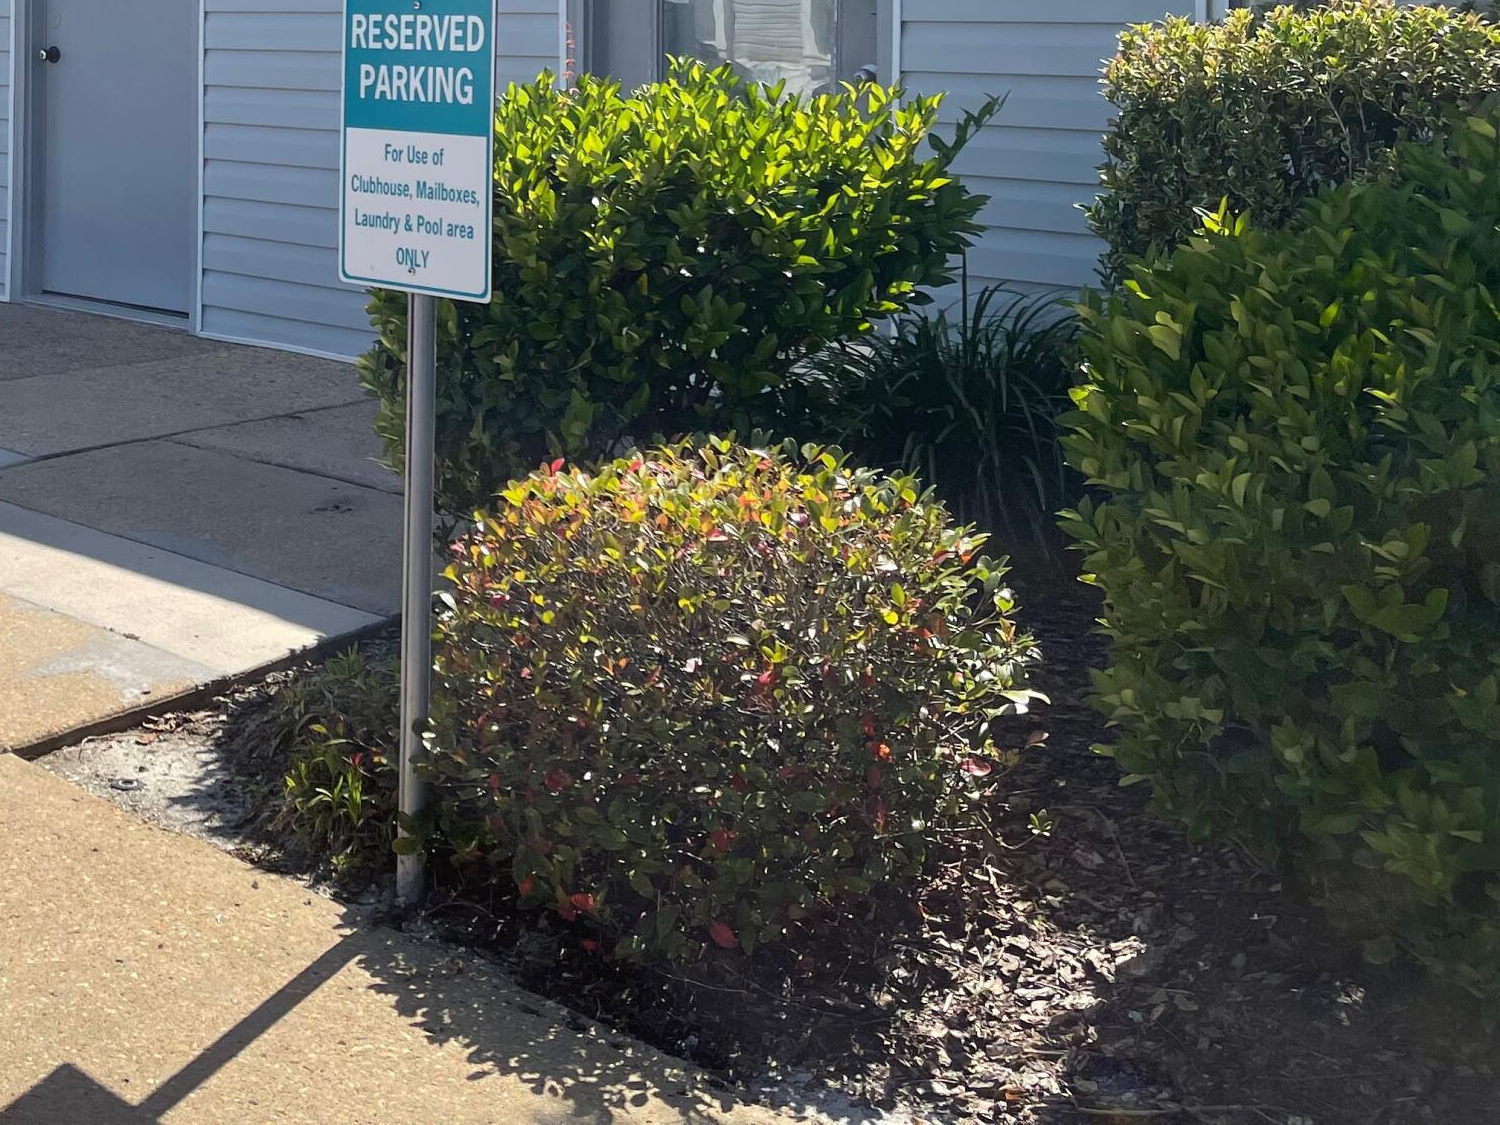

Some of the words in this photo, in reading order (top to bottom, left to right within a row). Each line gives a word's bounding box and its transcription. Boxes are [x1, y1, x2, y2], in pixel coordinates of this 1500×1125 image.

[351, 14, 485, 52] RESERVED
[359, 64, 473, 105] PARKING
[384, 144, 403, 162] For
[407, 145, 428, 164] Use
[432, 148, 444, 166] of
[351, 175, 413, 200] Clubhouse,
[416, 181, 480, 206] Mailboxes,
[355, 209, 400, 234] Laundry
[404, 214, 413, 232] &
[417, 215, 443, 235] Pool
[447, 224, 474, 239] area
[396, 247, 430, 268] ONLY
